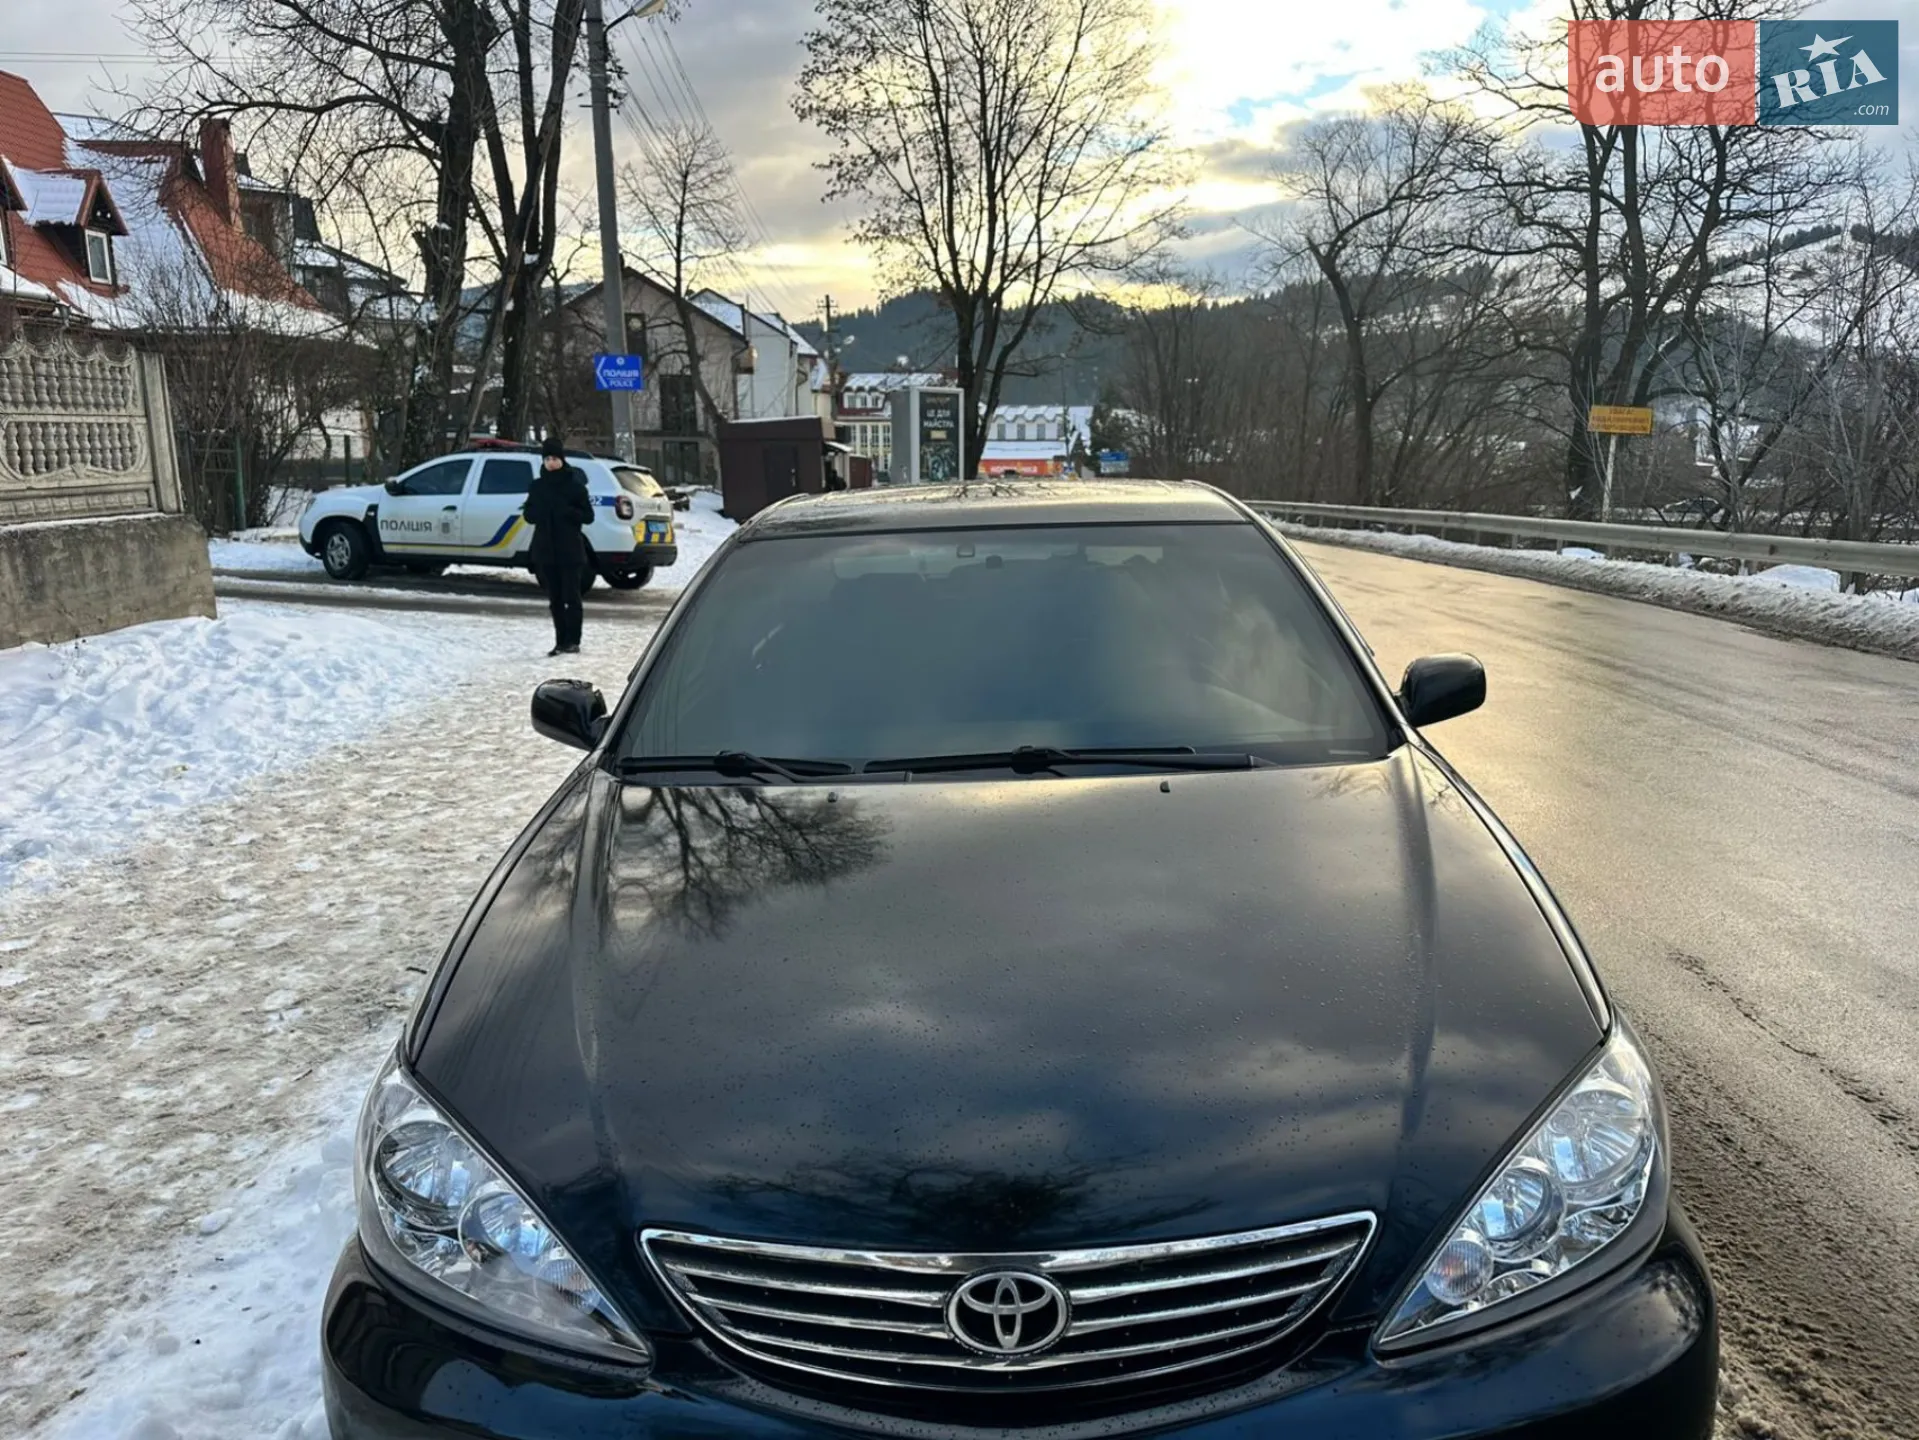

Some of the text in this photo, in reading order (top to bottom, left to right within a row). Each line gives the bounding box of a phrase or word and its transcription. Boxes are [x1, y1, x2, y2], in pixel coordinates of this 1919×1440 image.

[602, 368, 639, 378] ПОЛІЦІЯ
[609, 379, 633, 387] POLICE
[588, 495, 603, 505] 02
[380, 519, 433, 532] ПОЛІЦІЯ
